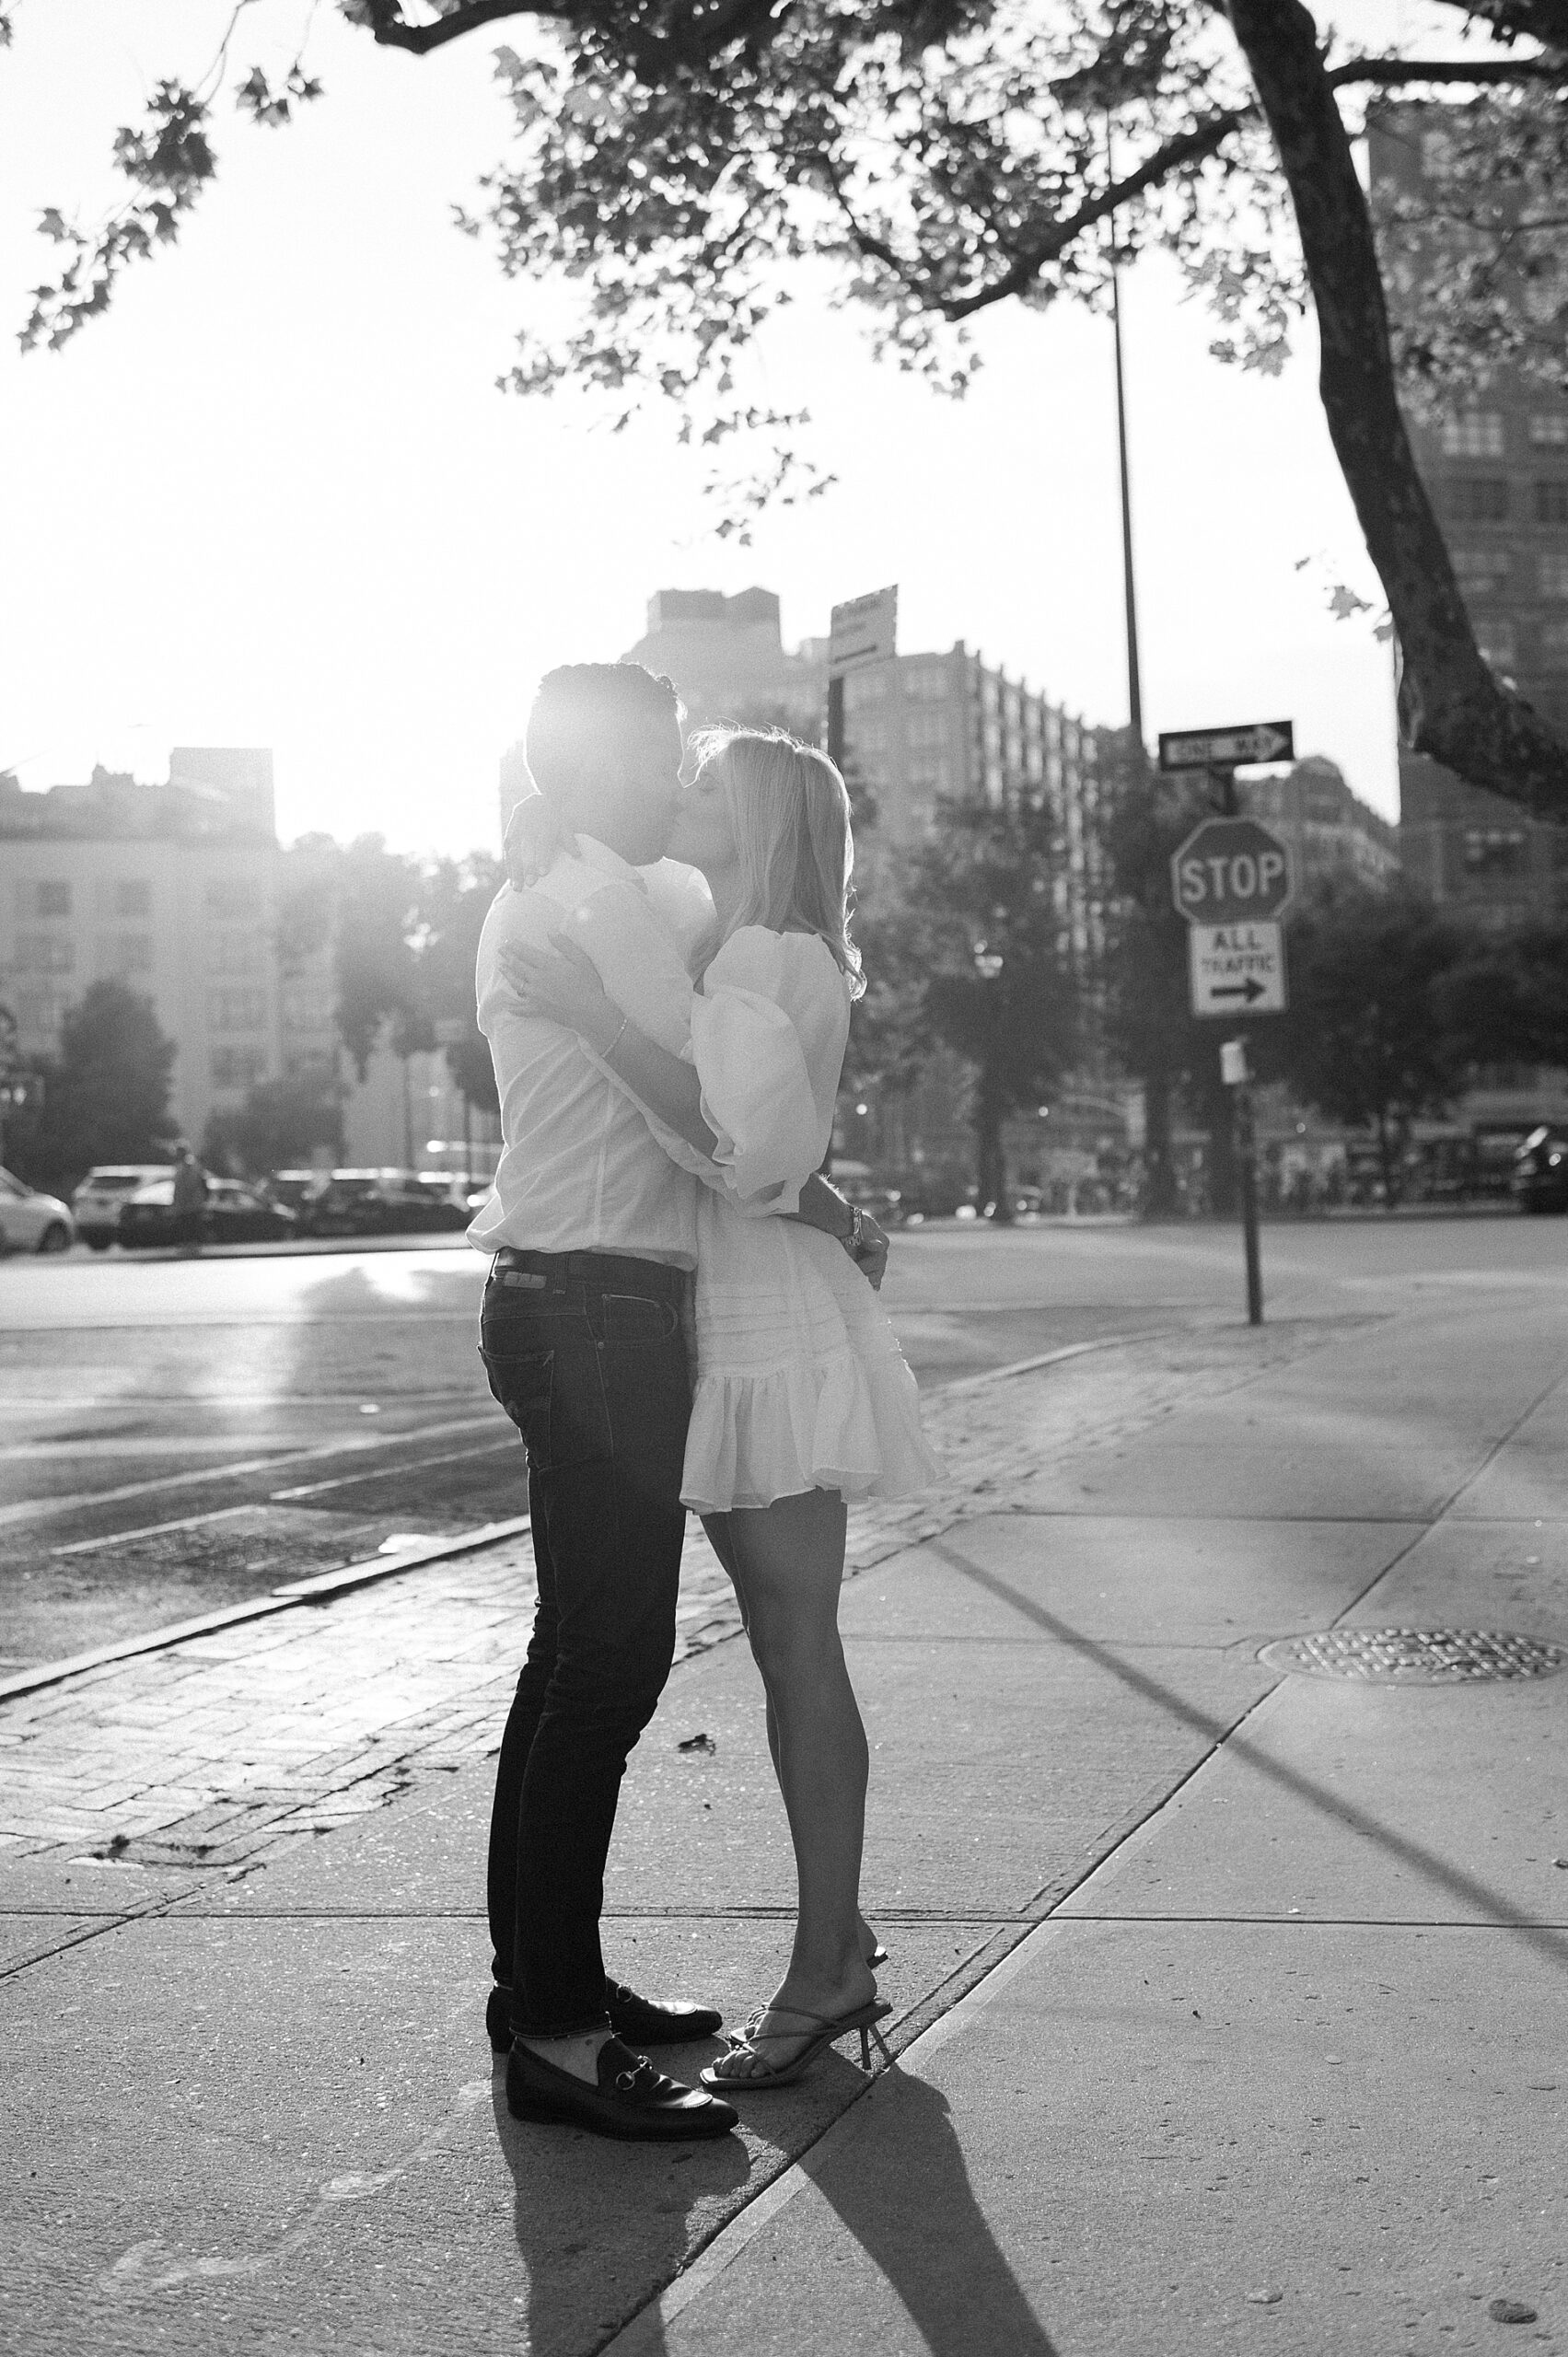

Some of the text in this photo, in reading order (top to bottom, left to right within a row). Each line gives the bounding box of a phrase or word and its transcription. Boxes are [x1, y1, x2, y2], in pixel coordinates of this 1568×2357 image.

[1182, 852, 1283, 902] STOP
[1214, 929, 1261, 951] ALL
[1202, 953, 1275, 974] TRAFFIC
